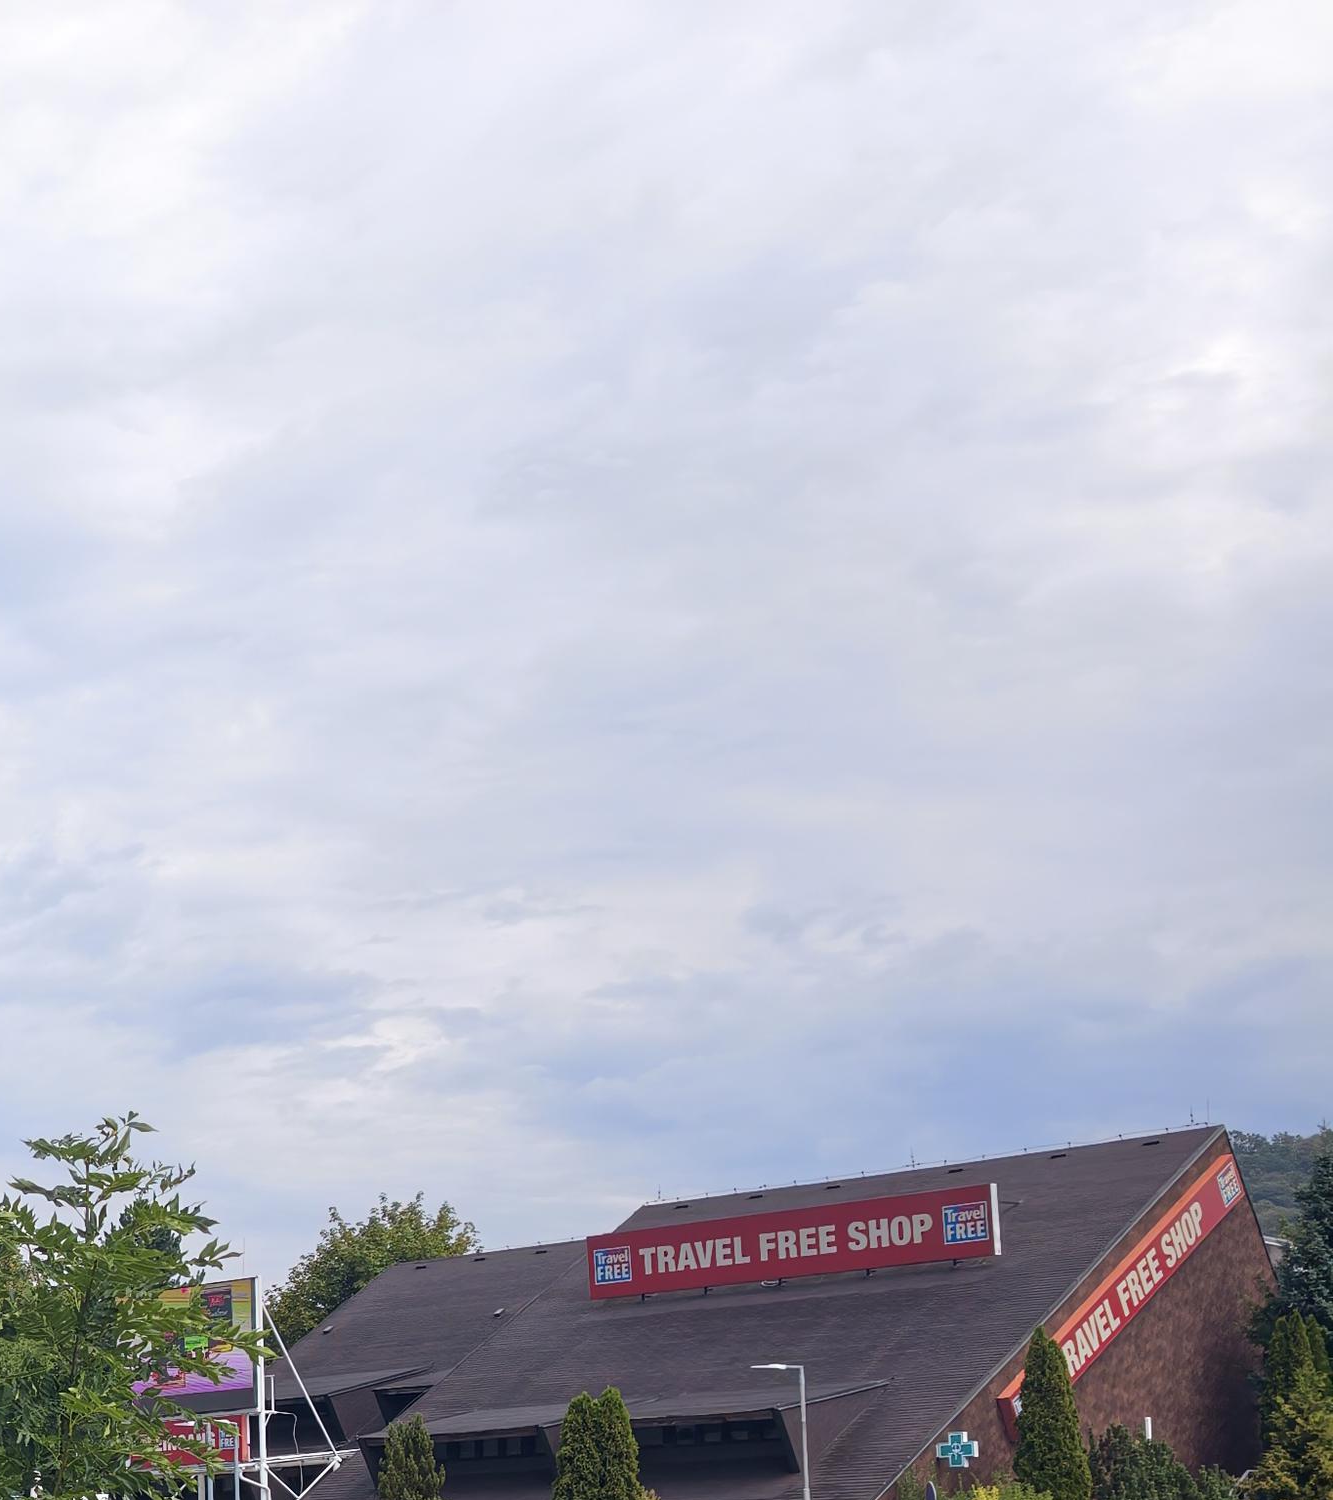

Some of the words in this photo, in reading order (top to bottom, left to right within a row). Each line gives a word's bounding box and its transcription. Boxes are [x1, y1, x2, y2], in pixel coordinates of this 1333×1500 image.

[944, 1205, 985, 1222] Travel
[947, 1220, 986, 1241] FREE
[639, 1236, 751, 1275] TRAVEL
[759, 1224, 837, 1262] FREE
[847, 1213, 933, 1251] SHOP
[595, 1249, 629, 1265] Travel
[597, 1263, 630, 1281] FREE
[1062, 1299, 1121, 1378] RAVEL
[1116, 1247, 1164, 1317] FREE
[1161, 1202, 1203, 1268] SHOP
